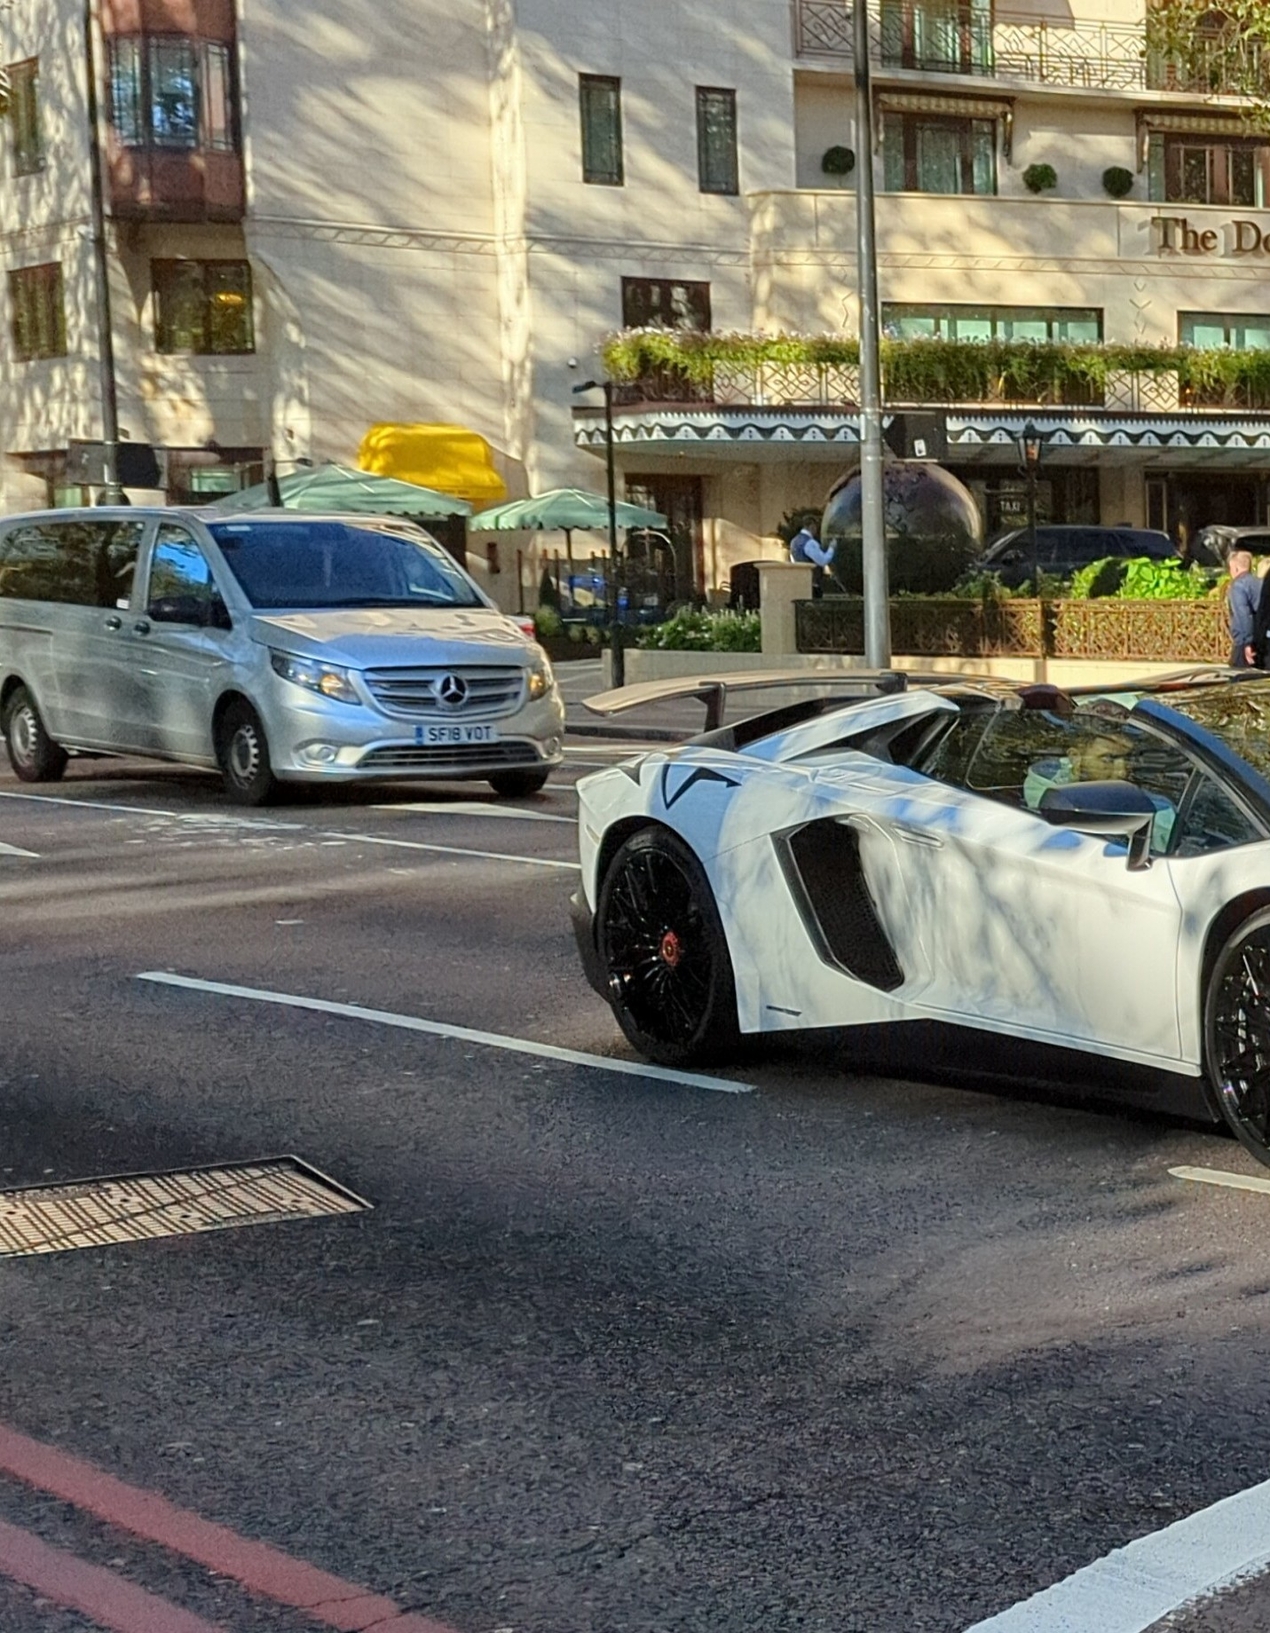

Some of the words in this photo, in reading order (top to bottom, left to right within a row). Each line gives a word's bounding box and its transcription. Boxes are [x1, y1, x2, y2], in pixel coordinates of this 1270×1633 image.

[1151, 216, 1218, 251] The
[1000, 501, 1021, 512] TAXI
[428, 727, 461, 742] SF18
[464, 726, 492, 741] VOT
